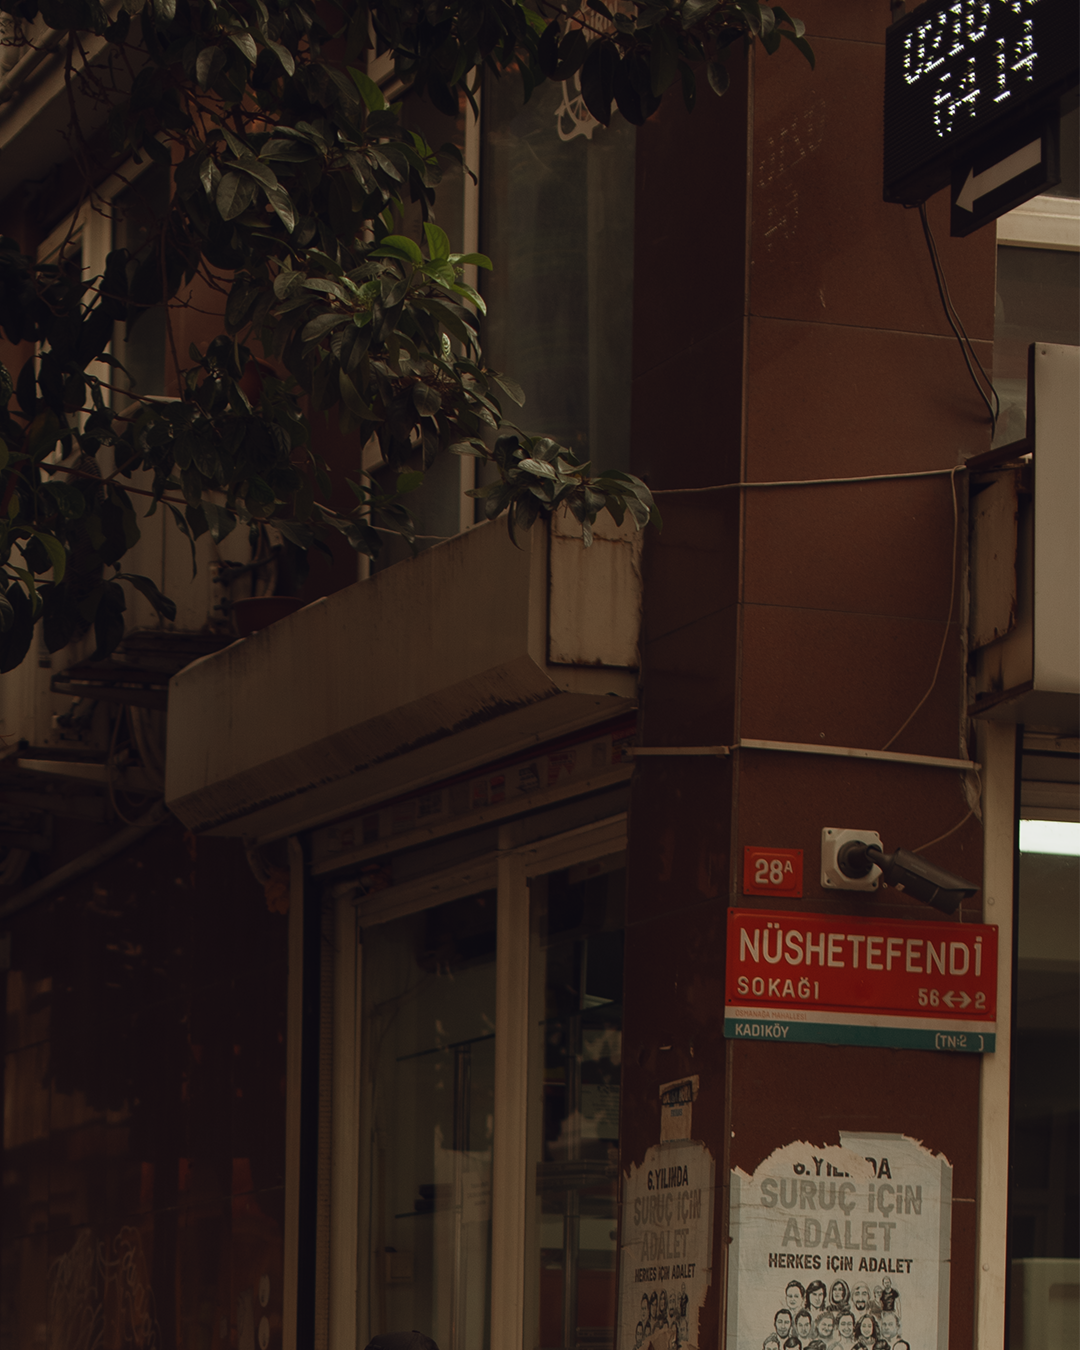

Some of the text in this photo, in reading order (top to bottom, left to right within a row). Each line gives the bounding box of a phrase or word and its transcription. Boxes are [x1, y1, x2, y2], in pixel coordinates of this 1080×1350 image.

[739, 921, 983, 977] NÜSHETEFENDİ
[736, 975, 820, 1001] SOKAĞI
[918, 987, 940, 1007] 56
[735, 1022, 790, 1039] KADIKÖY
[633, 1192, 673, 1227] SURUÇ
[760, 1178, 857, 1217] SURUÇ
[640, 1228, 690, 1262] ADALET
[781, 1217, 897, 1252] ADALET
[634, 1266, 657, 1283] HERKES
[671, 1263, 696, 1279] ADALET
[768, 1252, 822, 1270] HERKES
[858, 1257, 913, 1274] ADALET
